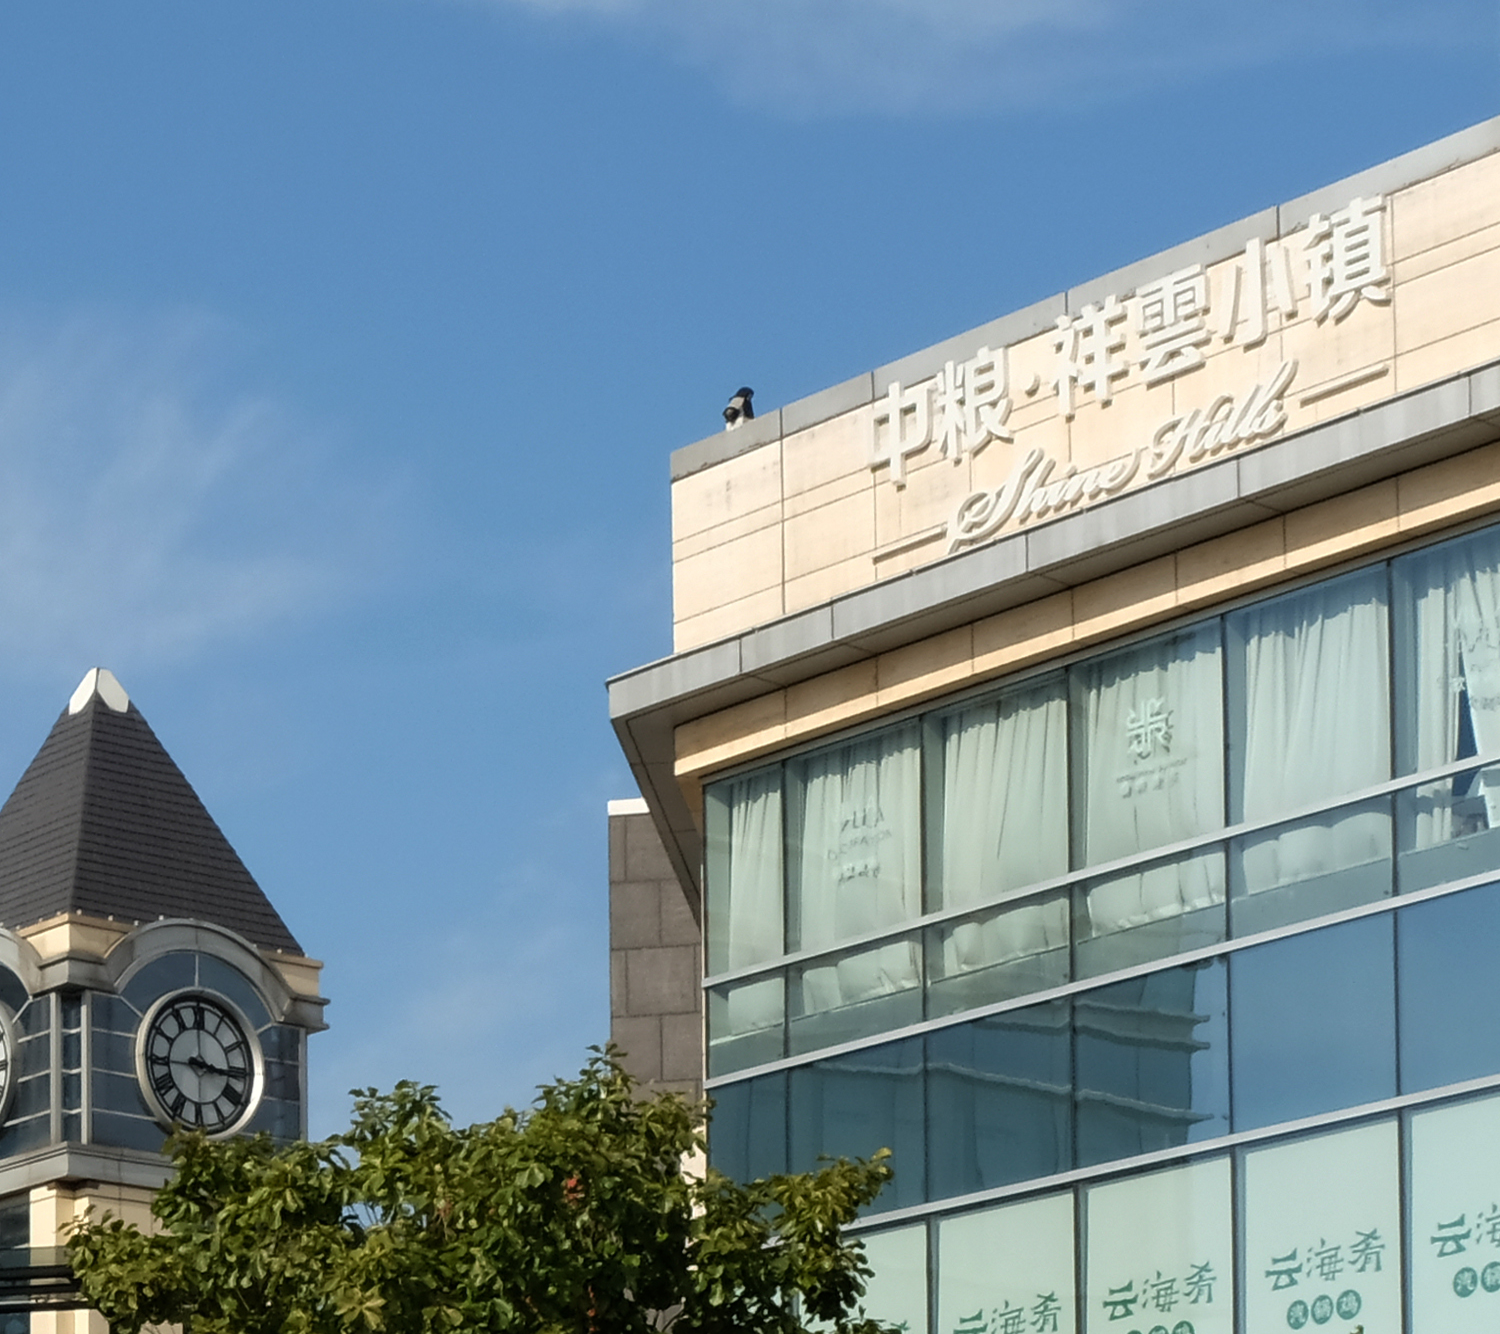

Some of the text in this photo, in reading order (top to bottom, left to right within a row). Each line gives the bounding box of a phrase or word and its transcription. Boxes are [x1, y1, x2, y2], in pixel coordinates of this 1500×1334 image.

[948, 358, 1297, 553] Shine Hills
[1102, 1260, 1217, 1321] 云海肴
[1265, 1227, 1385, 1292] 云海肴
